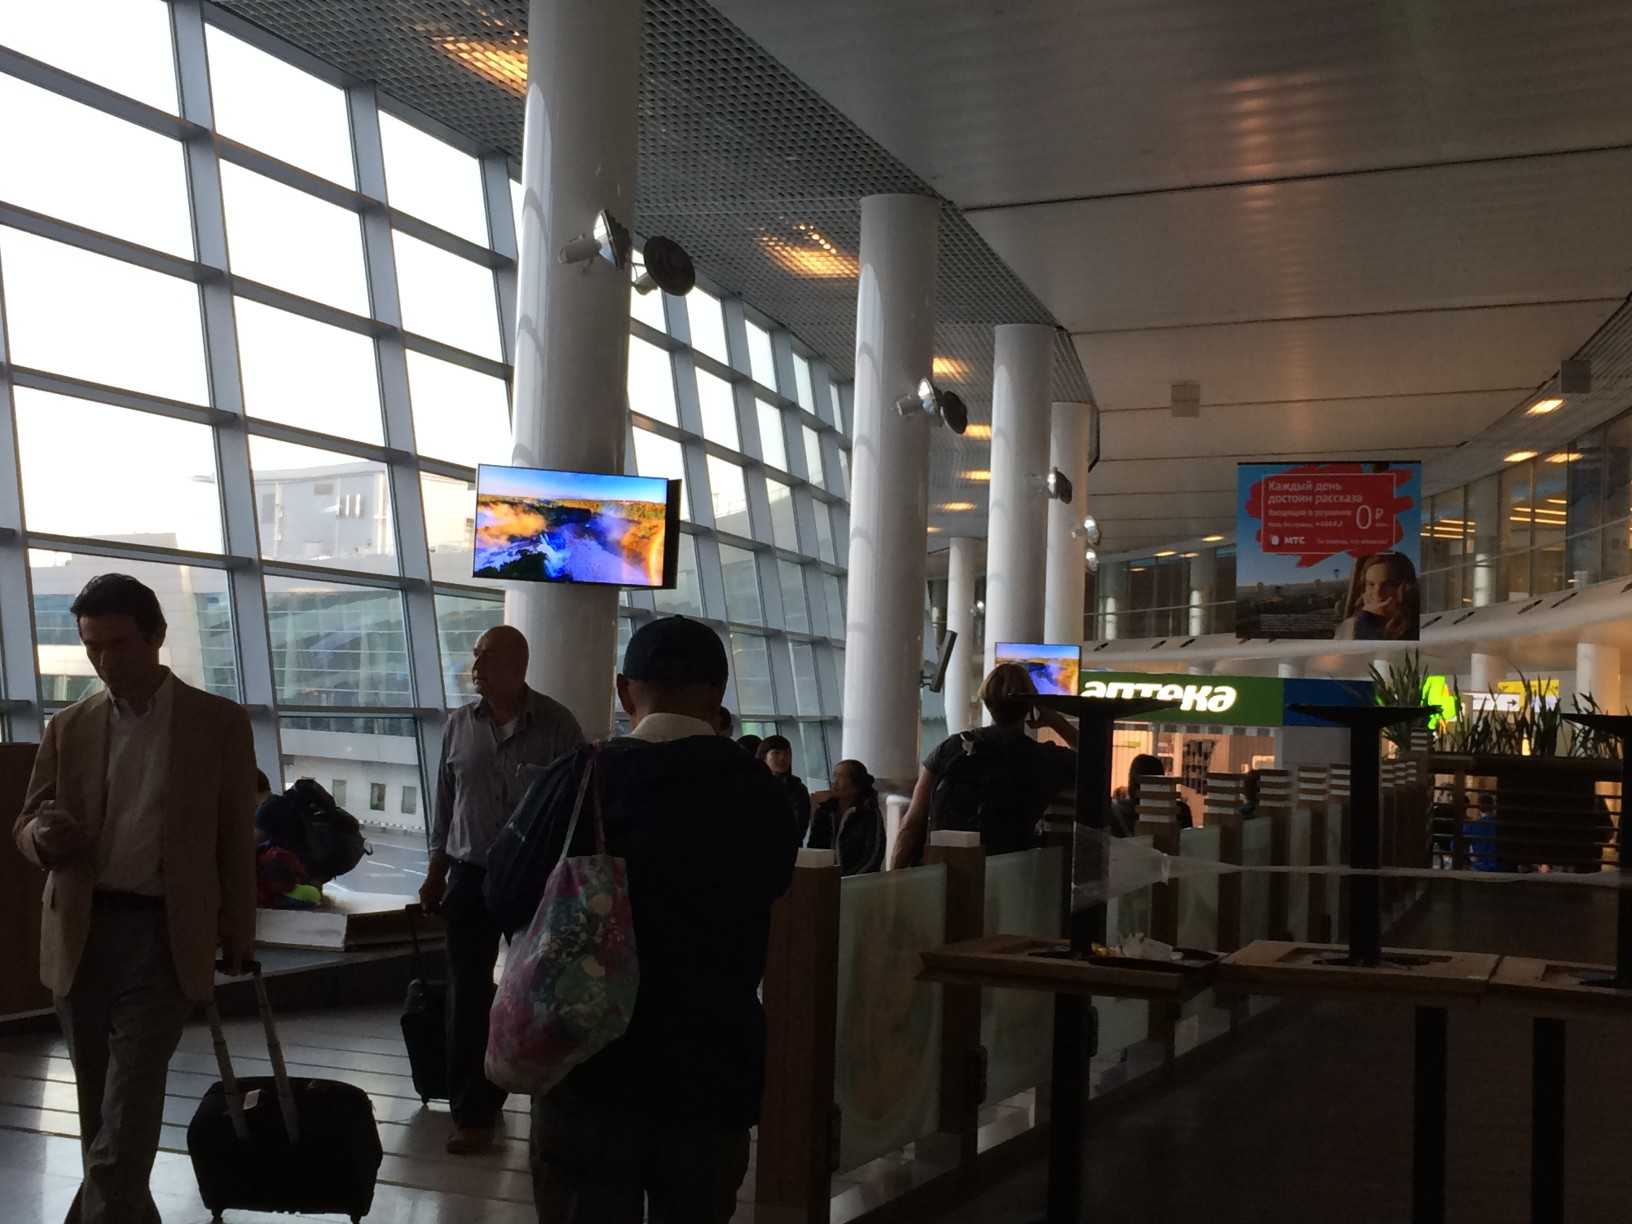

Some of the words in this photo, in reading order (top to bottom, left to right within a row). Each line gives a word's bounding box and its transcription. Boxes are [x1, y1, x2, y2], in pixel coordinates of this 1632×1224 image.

[1268, 480, 1313, 492] Каждый
[1314, 482, 1342, 492] день
[1268, 494, 1312, 504] достоин
[1315, 494, 1363, 505] рассказа
[1356, 504, 1372, 530] 0
[1080, 680, 1237, 713] аптека
